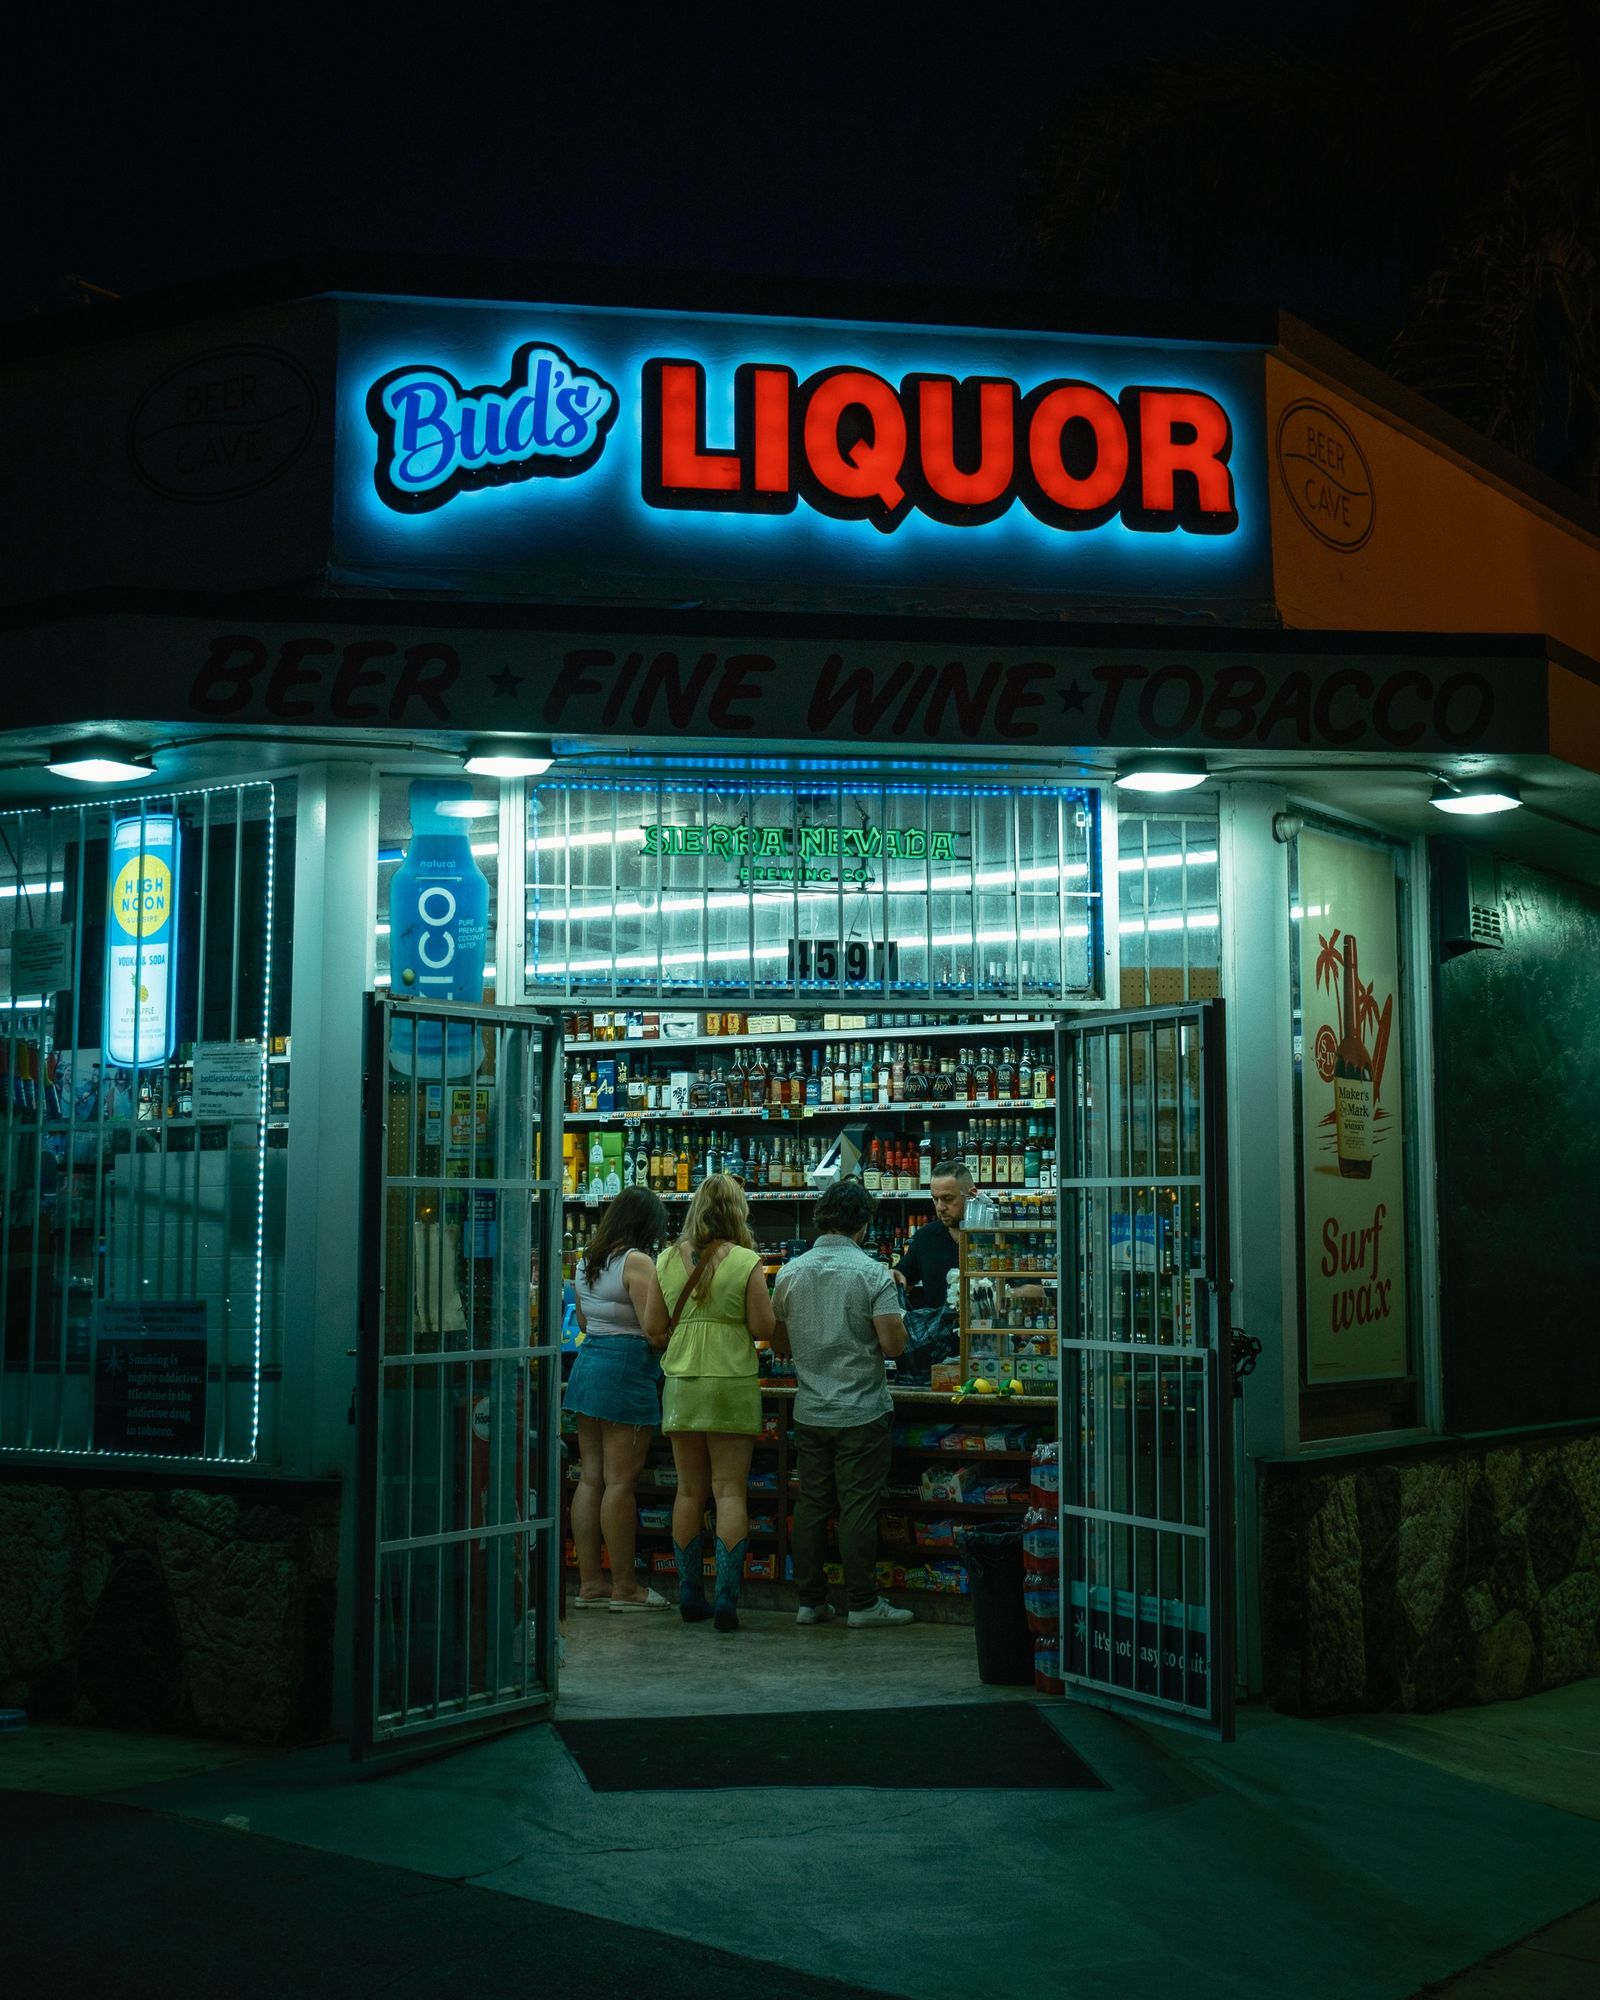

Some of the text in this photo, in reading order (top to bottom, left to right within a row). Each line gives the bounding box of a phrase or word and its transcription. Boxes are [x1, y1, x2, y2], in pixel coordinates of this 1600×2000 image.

[187, 376, 256, 417] BEER
[388, 355, 605, 486] Bud's
[660, 363, 1233, 514] LIQUOR
[176, 433, 264, 476] CAVE
[1307, 426, 1346, 476] BEER
[1304, 478, 1351, 528] CAVE
[189, 635, 1495, 747] BEER FINE WINE TOBACCO
[645, 824, 956, 862] SIERRA NEVADA
[419, 859, 457, 869] natural
[740, 866, 831, 881] BREWING
[125, 878, 164, 894] HIGH
[122, 895, 165, 912] NOON
[417, 886, 457, 1001] ICO
[457, 934, 485, 942] COCONUT
[457, 942, 477, 950] WATER
[149, 954, 166, 966] SODA
[1320, 1038, 1328, 1054] S
[1338, 1086, 1370, 1101] Maker's
[1347, 1103, 1369, 1118] Mark
[1322, 1203, 1387, 1281] Surf
[1331, 1278, 1392, 1334] wax
[127, 1352, 169, 1368] Smoking
[127, 1371, 203, 1386] highly addictive.
[127, 1388, 193, 1401] Nicotine is the
[127, 1407, 192, 1423] addictive drug
[126, 1424, 177, 1437] in tobacco.
[1092, 1629, 1111, 1651] It's
[1138, 1644, 1160, 1670] asy
